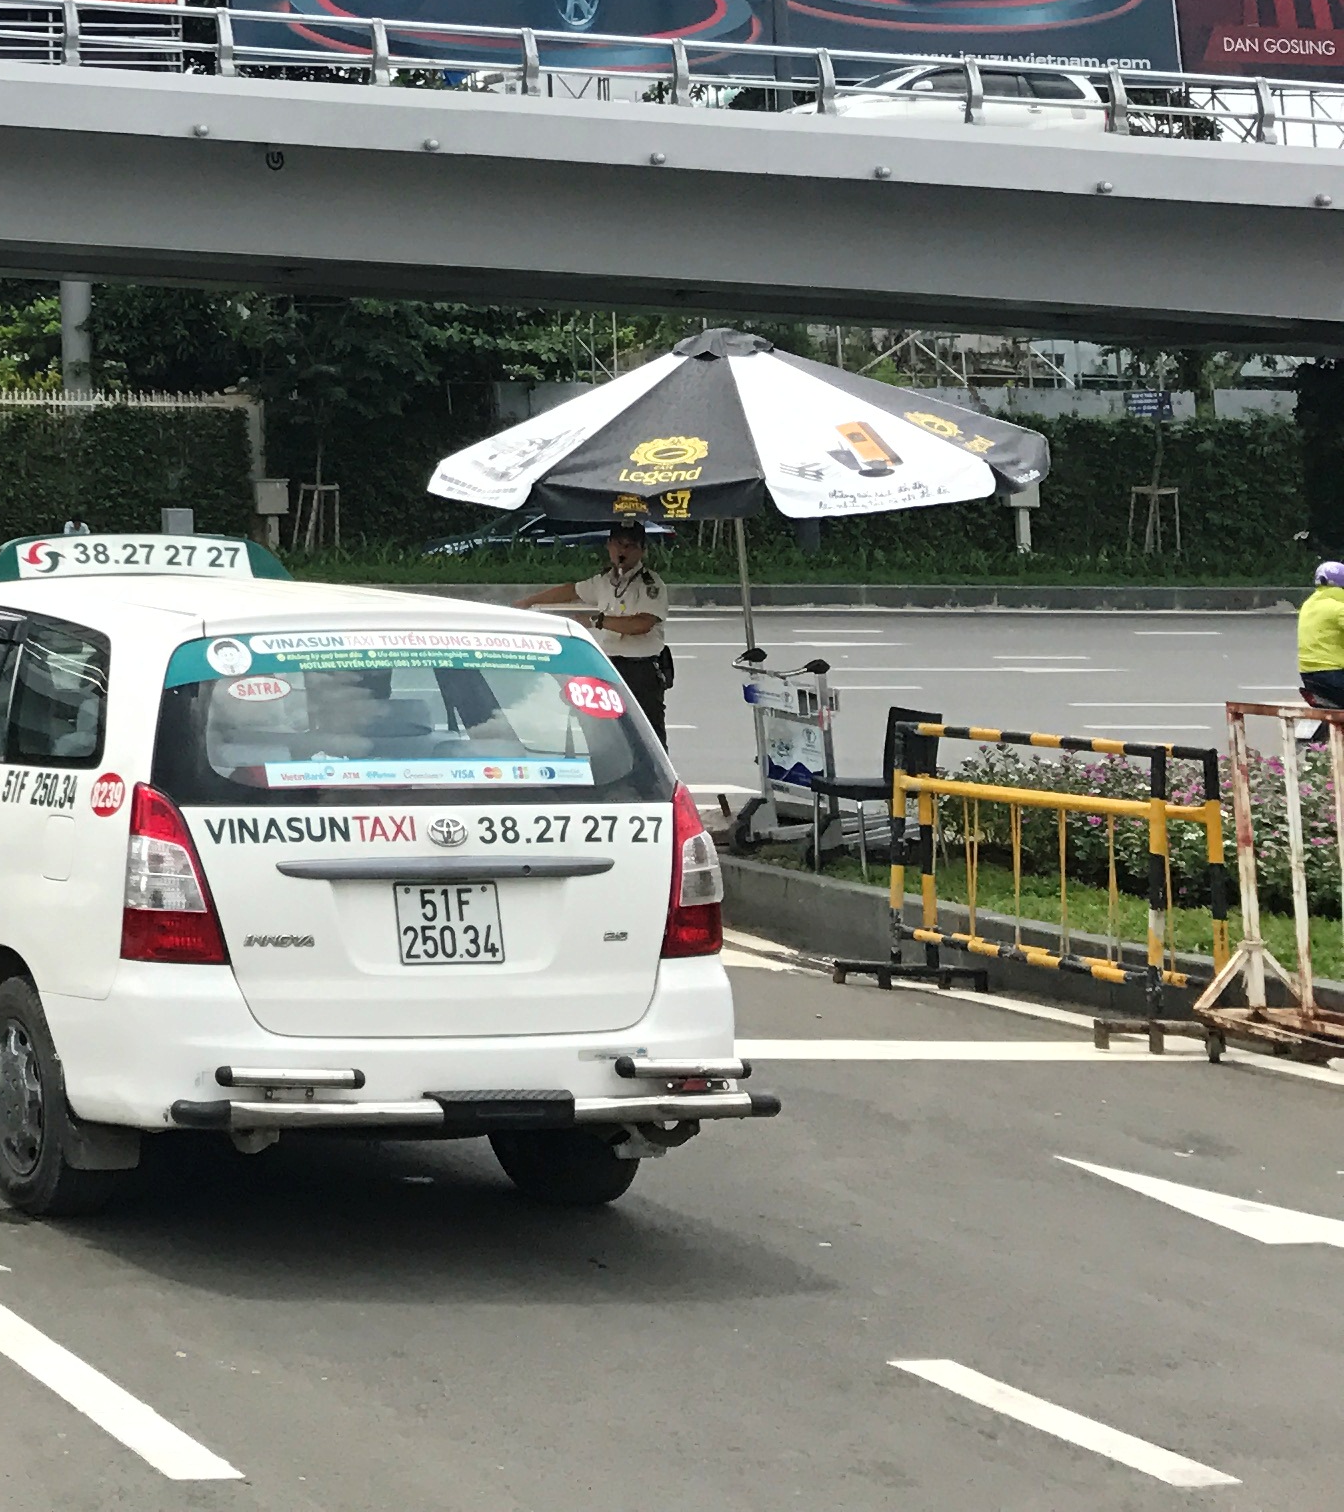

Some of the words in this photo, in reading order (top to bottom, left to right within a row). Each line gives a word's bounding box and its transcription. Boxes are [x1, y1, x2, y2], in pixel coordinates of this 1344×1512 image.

[1223, 36, 1260, 54] DAN
[1264, 37, 1336, 57] GOSLING
[619, 466, 702, 486] Legend
[73, 541, 154, 566] 38.27
[166, 543, 196, 568] 27
[208, 545, 240, 569] 27
[473, 636, 511, 648] 3.000
[536, 638, 554, 651] XE
[299, 661, 336, 669] HOTLINE
[236, 681, 282, 697] SATRA
[569, 681, 624, 715] 8239
[450, 770, 475, 779] VISA
[2, 770, 29, 804] 51F
[29, 771, 79, 810] 250.34
[91, 781, 124, 808] 8239
[478, 816, 571, 844] 38.27
[583, 816, 618, 844] 27
[629, 816, 663, 844] 27
[420, 888, 473, 923] 51F
[402, 924, 499, 961] 250.34
